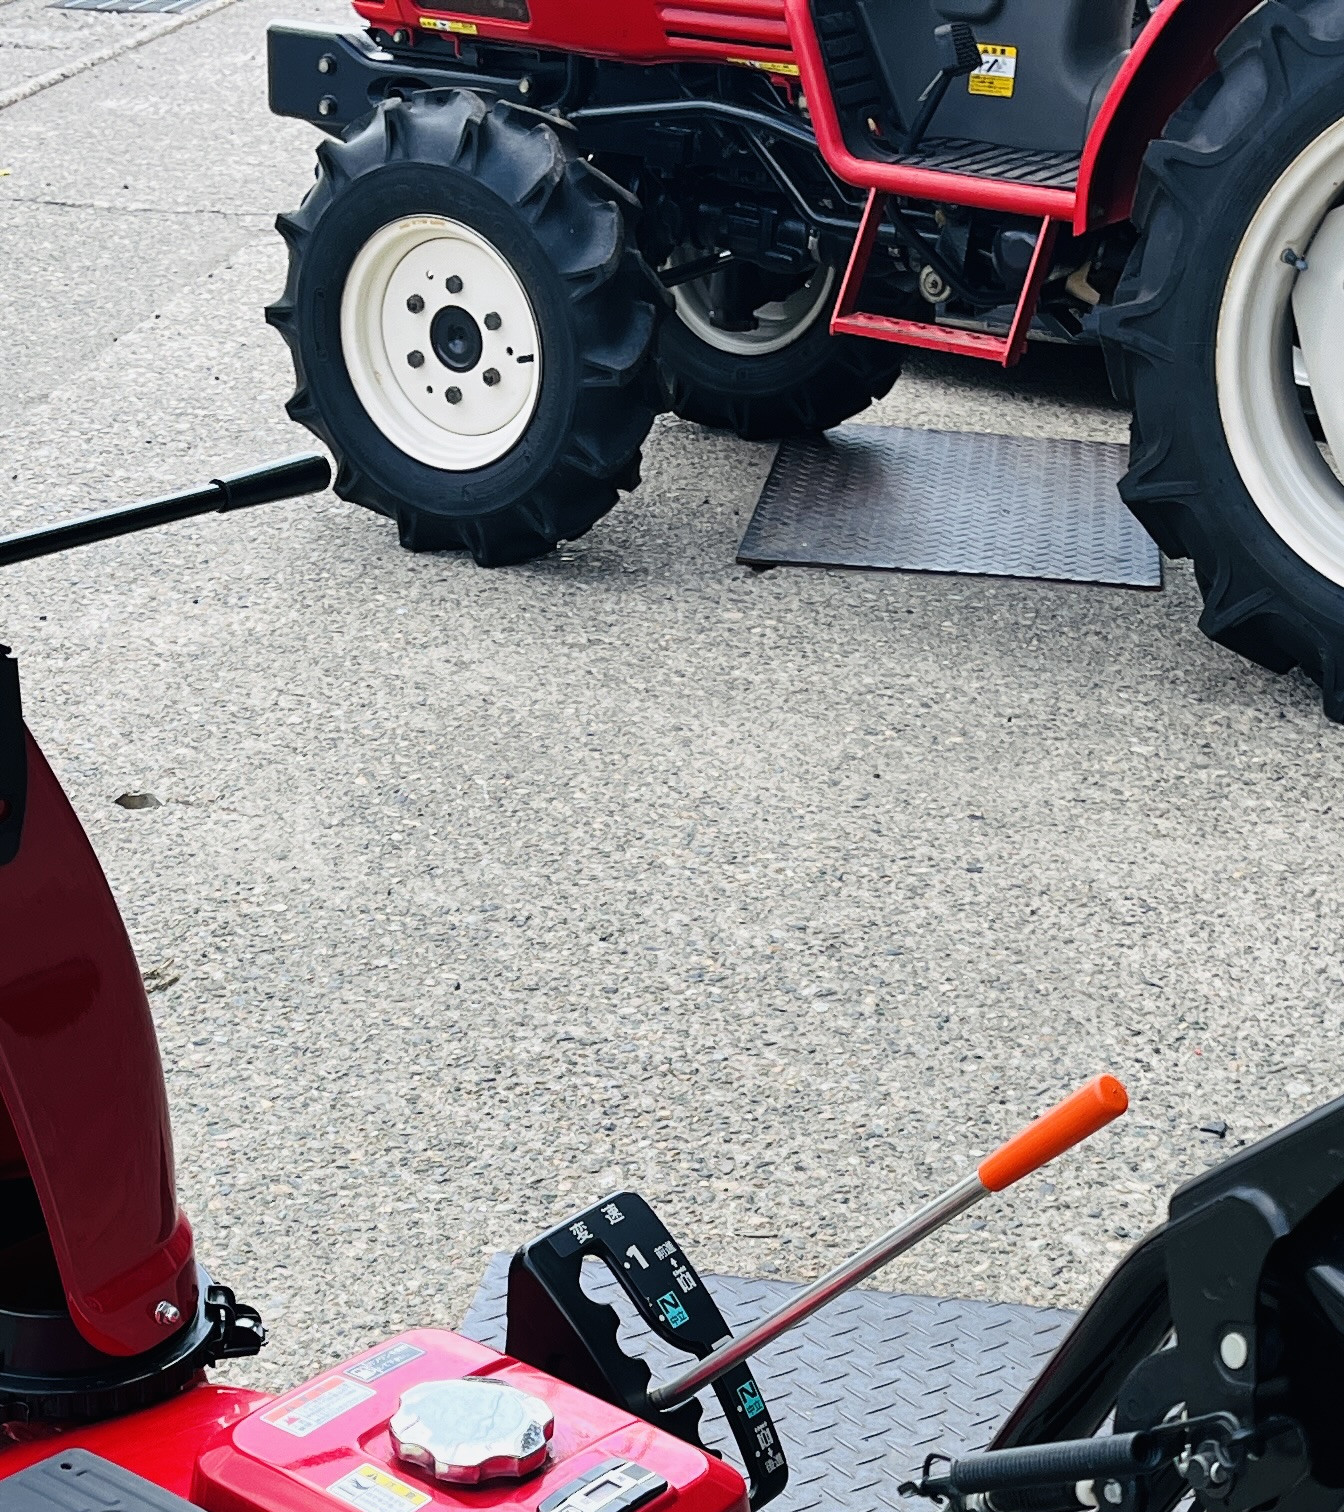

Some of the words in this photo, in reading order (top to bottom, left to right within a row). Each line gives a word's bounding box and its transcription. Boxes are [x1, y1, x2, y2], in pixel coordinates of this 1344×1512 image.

[626, 1245, 649, 1269] 1
[659, 1293, 681, 1314] N
[668, 1310, 689, 1328] 中立
[739, 1383, 758, 1404] N
[745, 1399, 763, 1417] 中立
